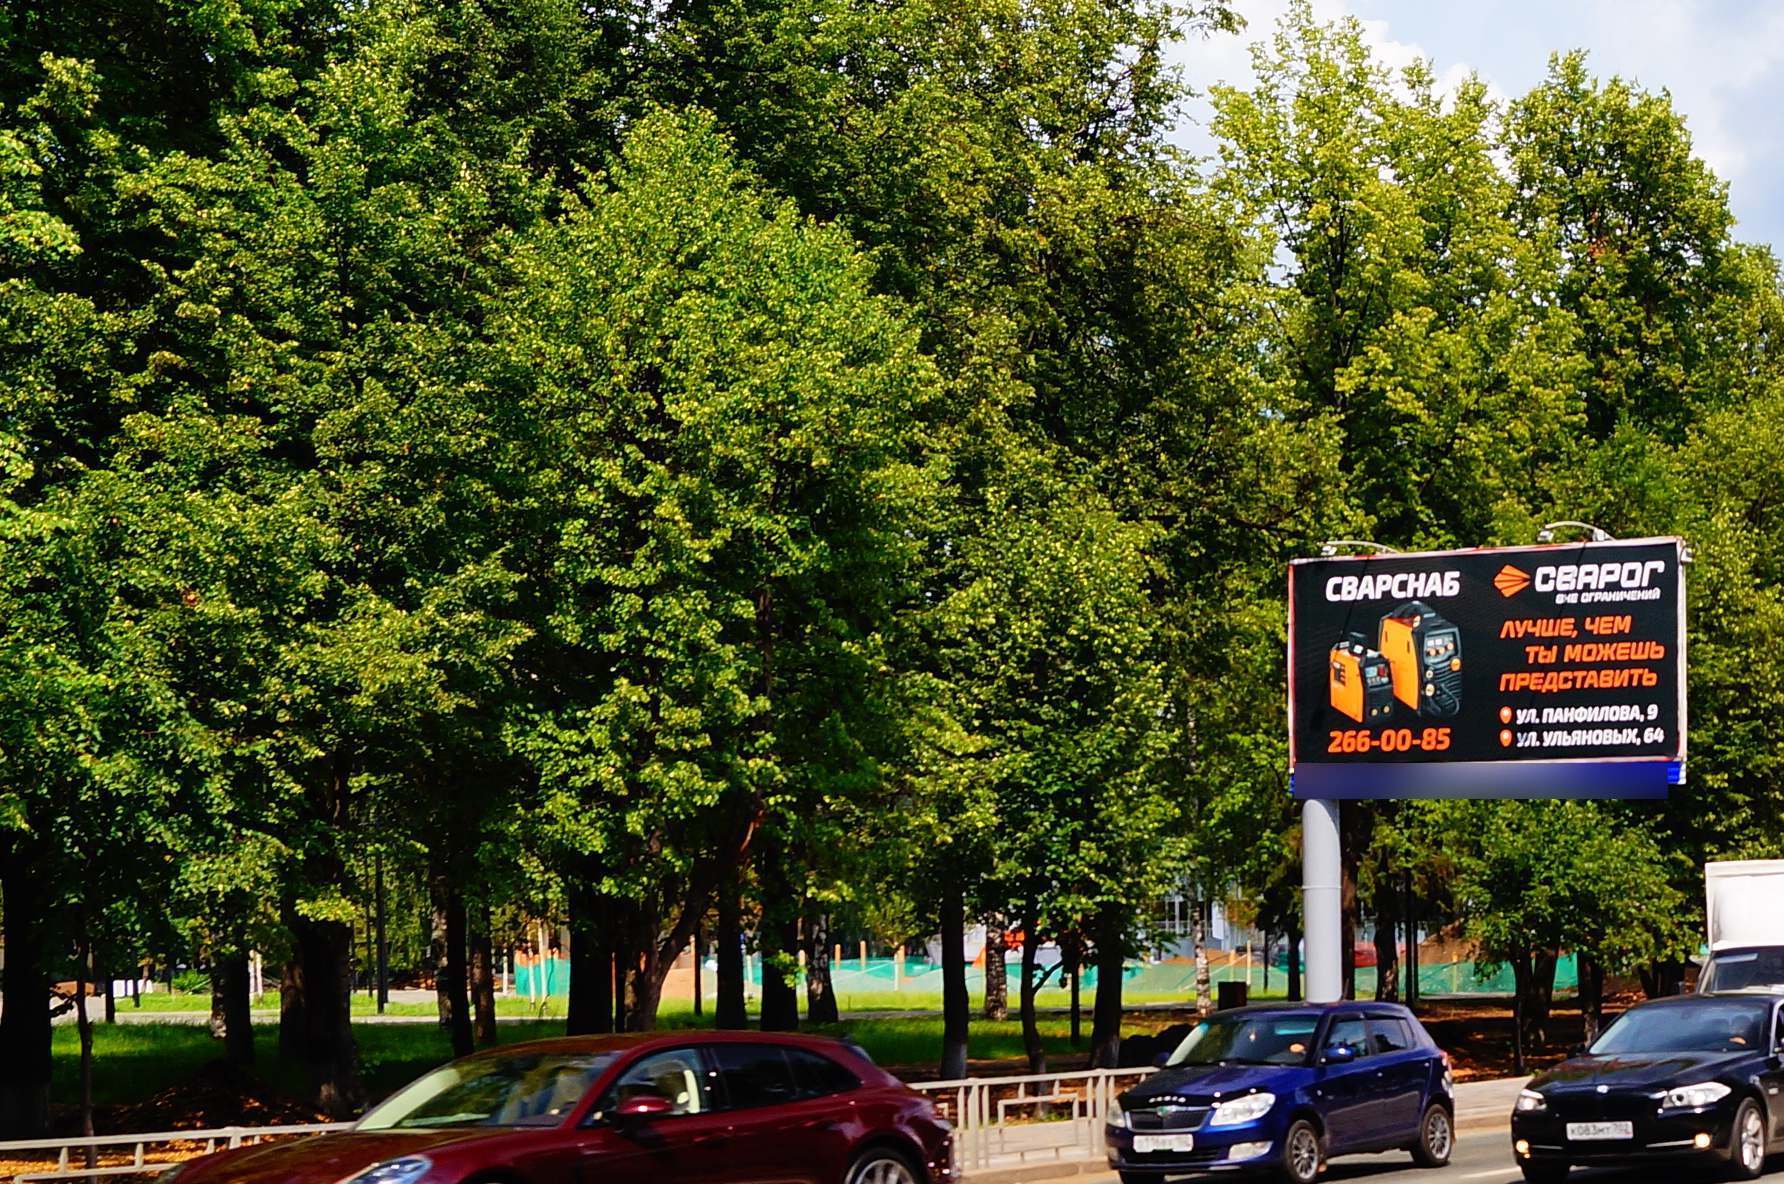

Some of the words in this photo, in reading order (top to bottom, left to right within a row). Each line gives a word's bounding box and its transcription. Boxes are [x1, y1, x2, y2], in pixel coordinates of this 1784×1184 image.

[1325, 571, 1461, 602] СВАРСНАБ
[1535, 560, 1665, 592] СВАРОГ
[1580, 587, 1661, 603] ОГРАНИЧЕНИЙ
[1500, 617, 1578, 639] ЛУЧШЕ,
[1584, 615, 1632, 635] ЧЕМ
[1525, 645, 1558, 664] ТЫ
[1563, 641, 1665, 663] МОЖЕШЬ
[1500, 668, 1658, 693] ПРЕДСТАВИТЬ
[1516, 708, 1540, 725] УЛ.
[1541, 704, 1645, 724] ПАНФИЛОВА,
[1646, 703, 1659, 720] 9
[1327, 727, 1452, 753] 266-00-85
[1516, 731, 1540, 748] УЛ.
[1541, 728, 1642, 747] УЛЬЯНОВЫХ,
[1643, 727, 1665, 743] 64
